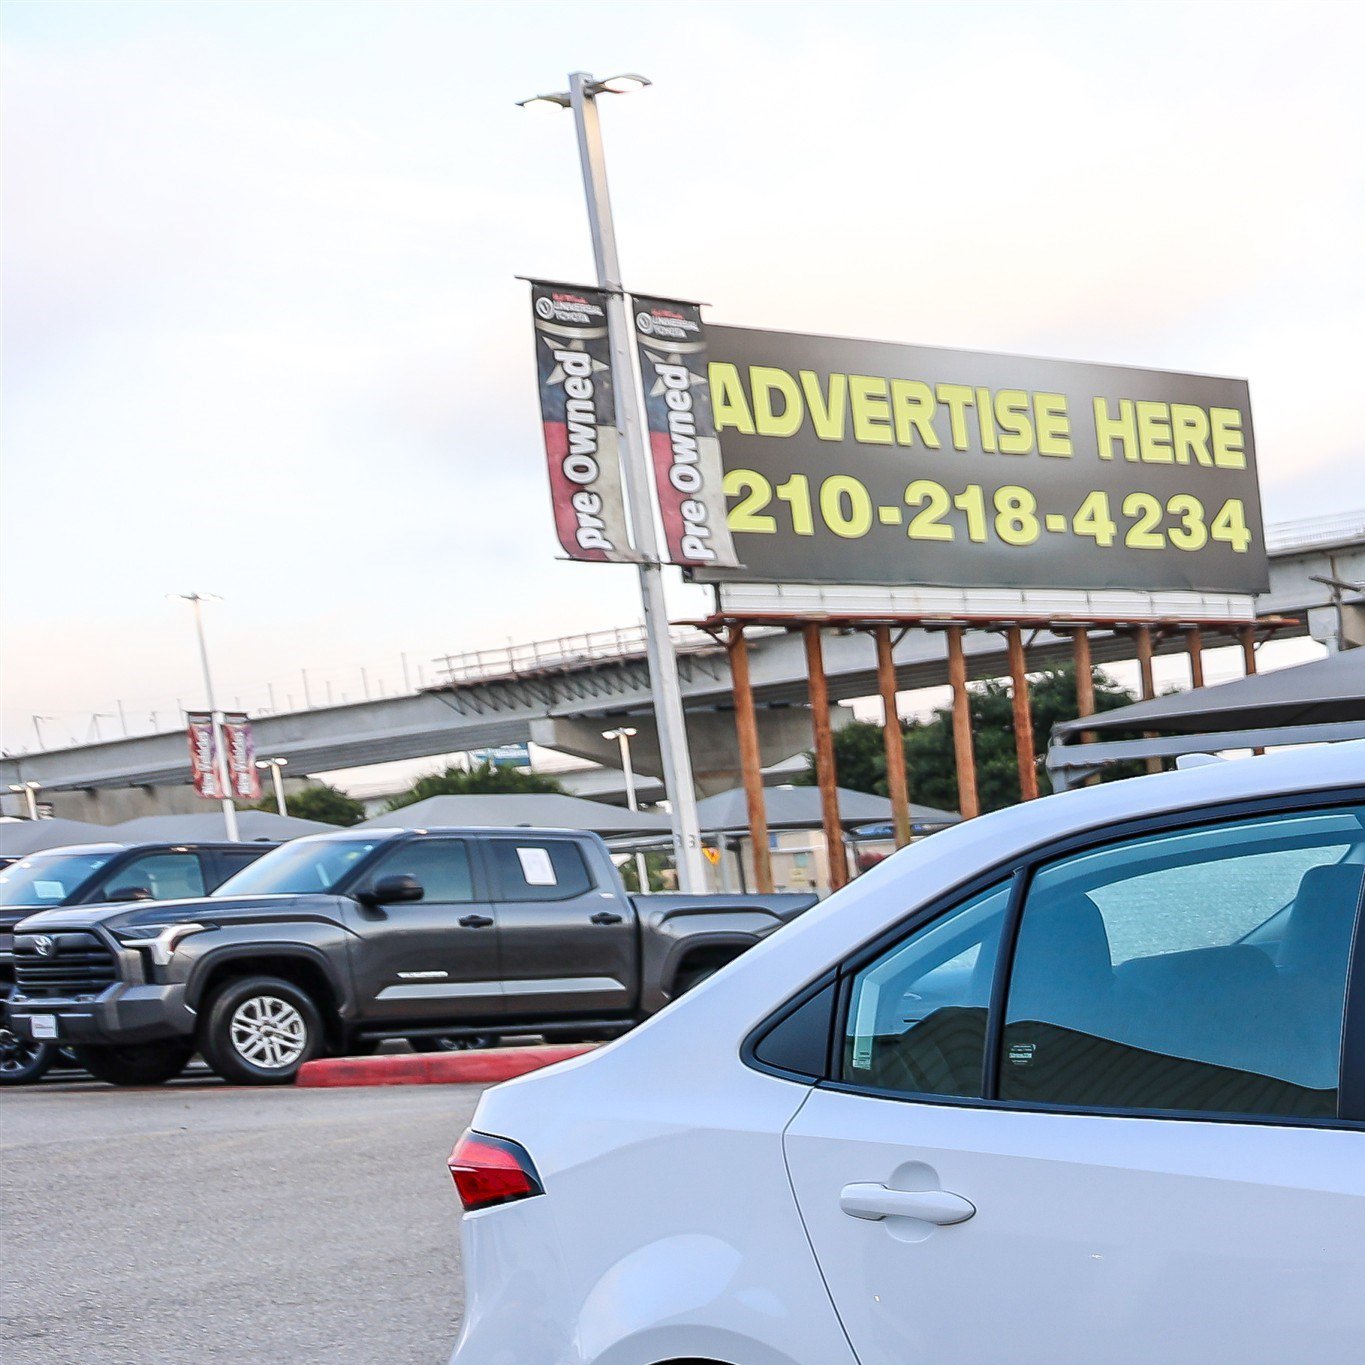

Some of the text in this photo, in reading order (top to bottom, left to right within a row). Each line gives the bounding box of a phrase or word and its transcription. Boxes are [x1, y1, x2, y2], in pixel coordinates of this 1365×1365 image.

[553, 350, 600, 485] Owned
[654, 363, 704, 494] Owned
[708, 361, 1248, 469] ADVERTISE HERE
[723, 468, 1252, 552] 210-218-4234
